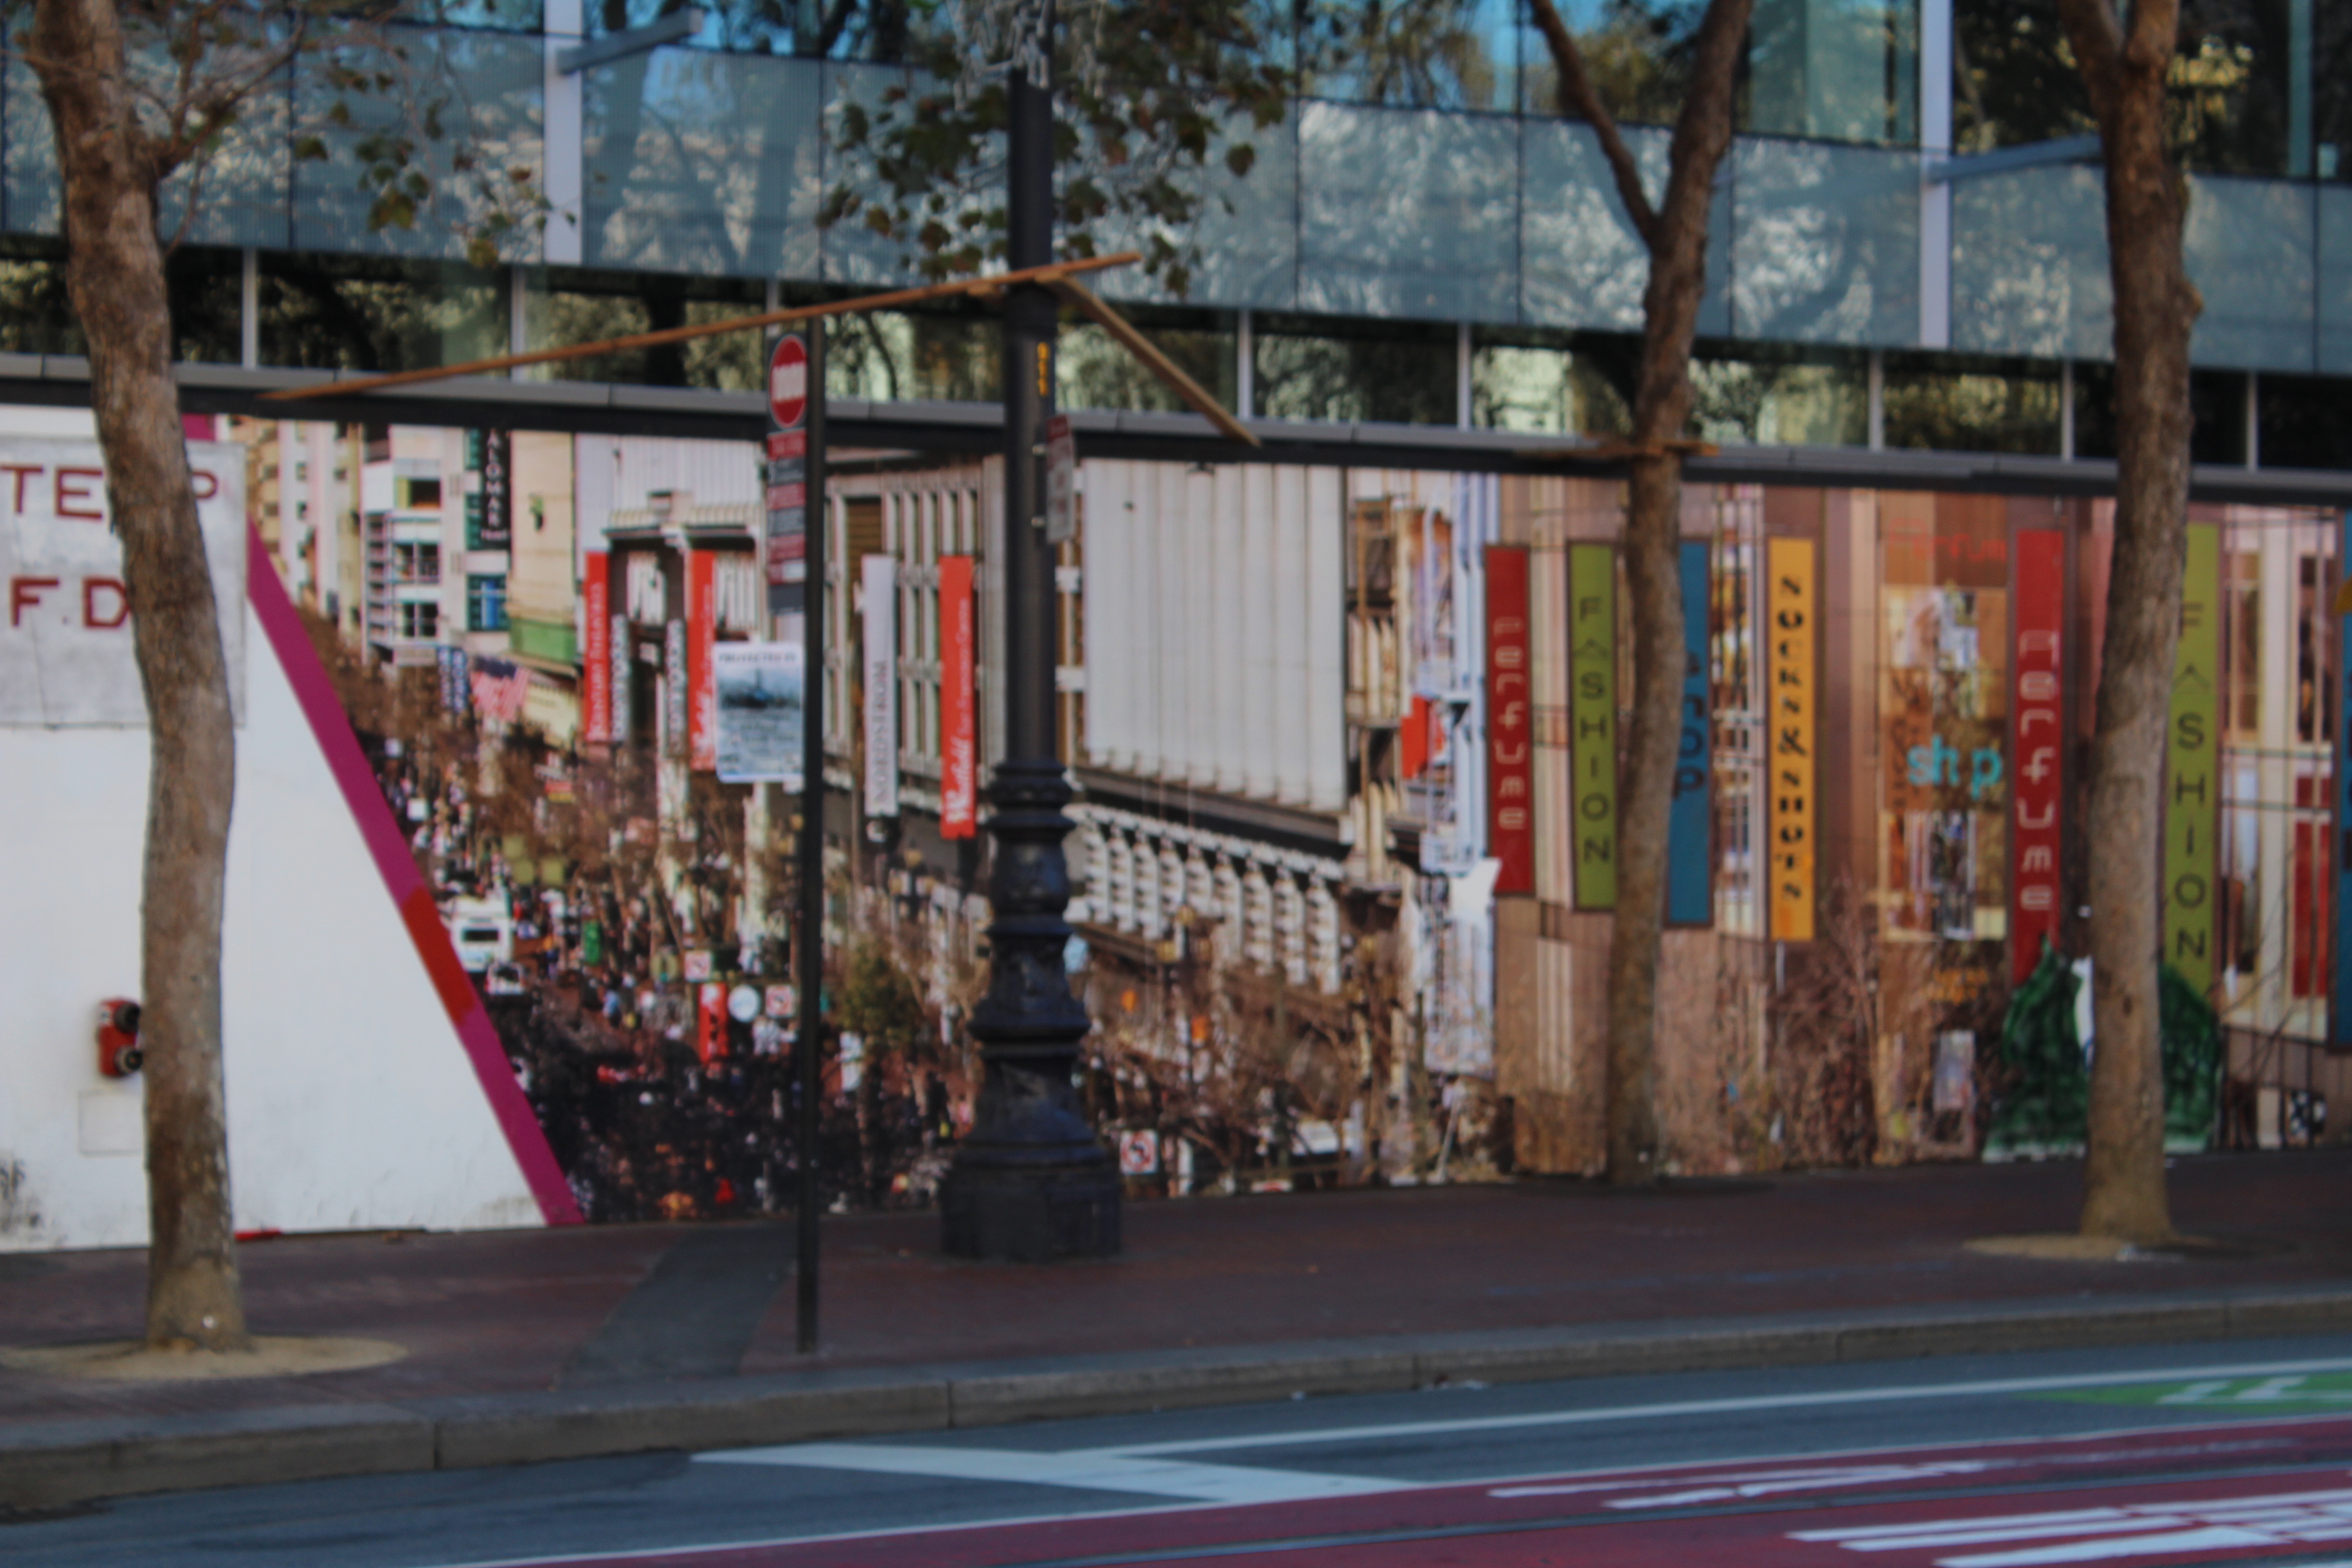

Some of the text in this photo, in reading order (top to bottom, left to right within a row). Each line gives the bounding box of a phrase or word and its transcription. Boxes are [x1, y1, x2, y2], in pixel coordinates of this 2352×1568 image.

[0, 464, 218, 519] TEP
[1573, 596, 1611, 865] FASHION
[2172, 602, 2211, 960] FASHION
